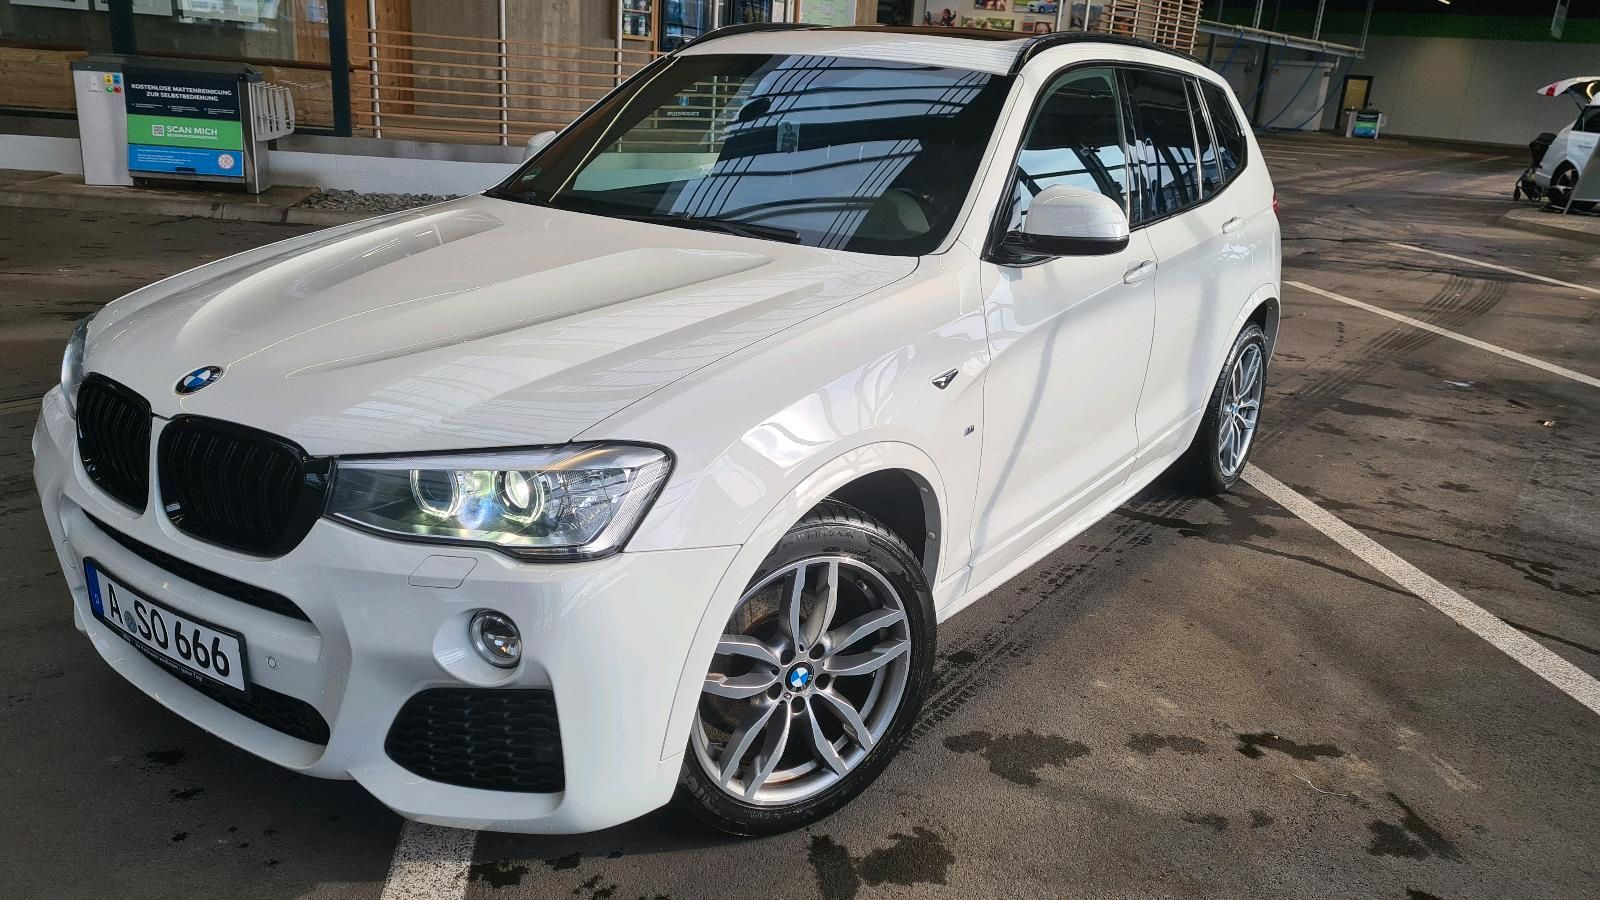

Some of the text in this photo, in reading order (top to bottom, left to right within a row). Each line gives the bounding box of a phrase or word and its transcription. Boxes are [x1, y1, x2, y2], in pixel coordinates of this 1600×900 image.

[131, 83, 232, 96] KOSTENLOSE MATTENREINIGUNG
[160, 92, 219, 102] SELBSTBEDIENUNG
[166, 125, 218, 136] SCAN MICH
[107, 582, 124, 625] A
[133, 599, 169, 650] SO
[174, 620, 231, 678] 666
